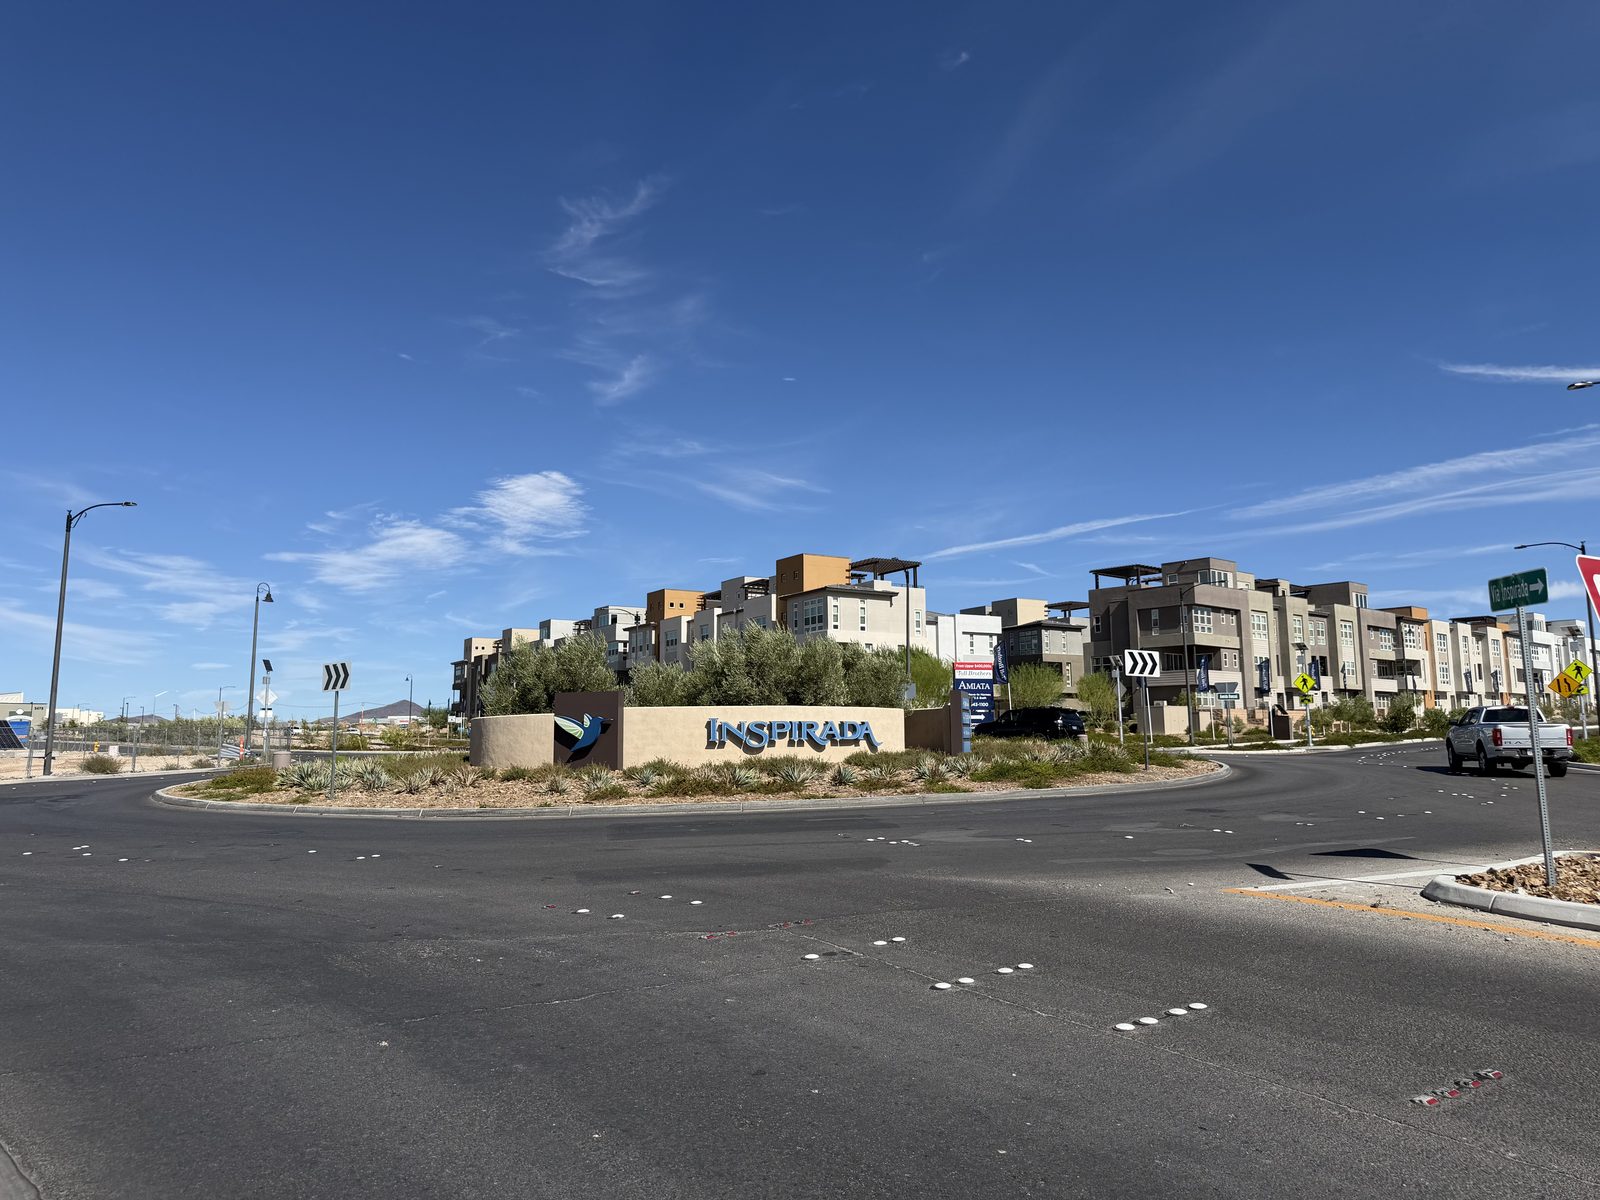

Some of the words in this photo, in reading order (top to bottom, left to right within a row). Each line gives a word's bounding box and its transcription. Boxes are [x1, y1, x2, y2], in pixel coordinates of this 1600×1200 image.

[1490, 585, 1500, 602] Via
[1501, 579, 1529, 604] Inspirada
[708, 717, 883, 748] INSPIRADA
